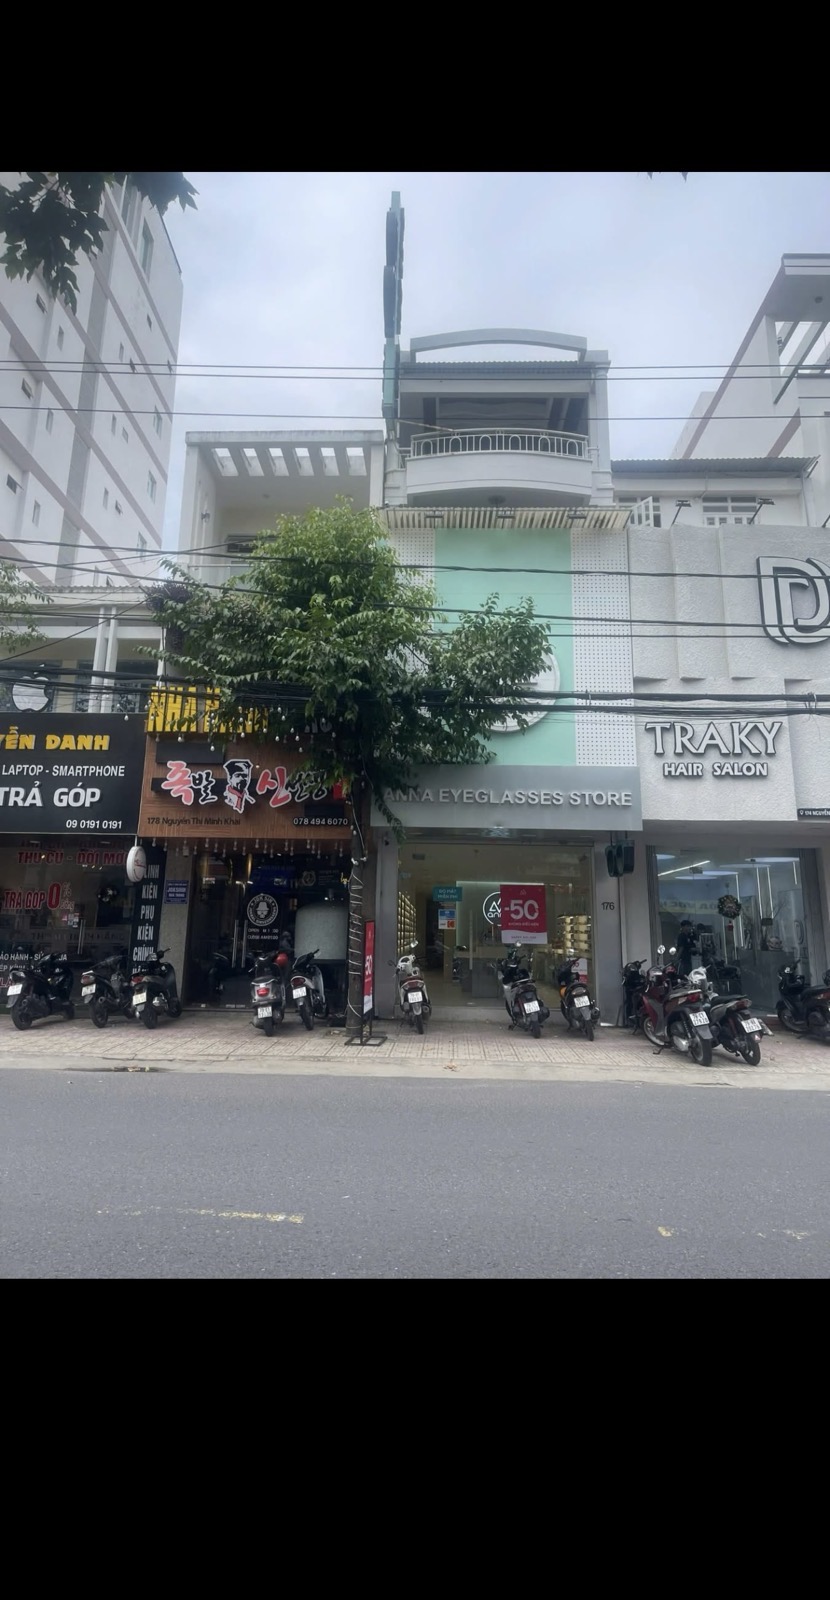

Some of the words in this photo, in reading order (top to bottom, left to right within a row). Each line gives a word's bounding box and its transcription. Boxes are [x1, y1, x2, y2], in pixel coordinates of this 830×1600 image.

[46, 734, 110, 751] DANH
[645, 721, 783, 756] TRAKY
[2, 764, 43, 776] LAPTOP
[52, 765, 125, 777] SMARTPHONE
[663, 762, 703, 777] HAIR
[712, 762, 768, 778] SALON
[161, 760, 218, 805] 족발
[0, 781, 43, 807] TRẢ
[53, 782, 101, 807] GÓP
[383, 788, 433, 803] ANNA
[439, 788, 564, 805] EYEGLASSES
[569, 790, 633, 806] STORE
[66, 820, 77, 829] 09
[80, 820, 99, 829] 0191
[102, 820, 122, 829] 0191
[147, 817, 160, 825] 178
[293, 817, 309, 825] 078
[310, 817, 326, 825] 494
[327, 817, 348, 825] 6070
[18, 851, 41, 864] THU
[601, 901, 615, 910] 176
